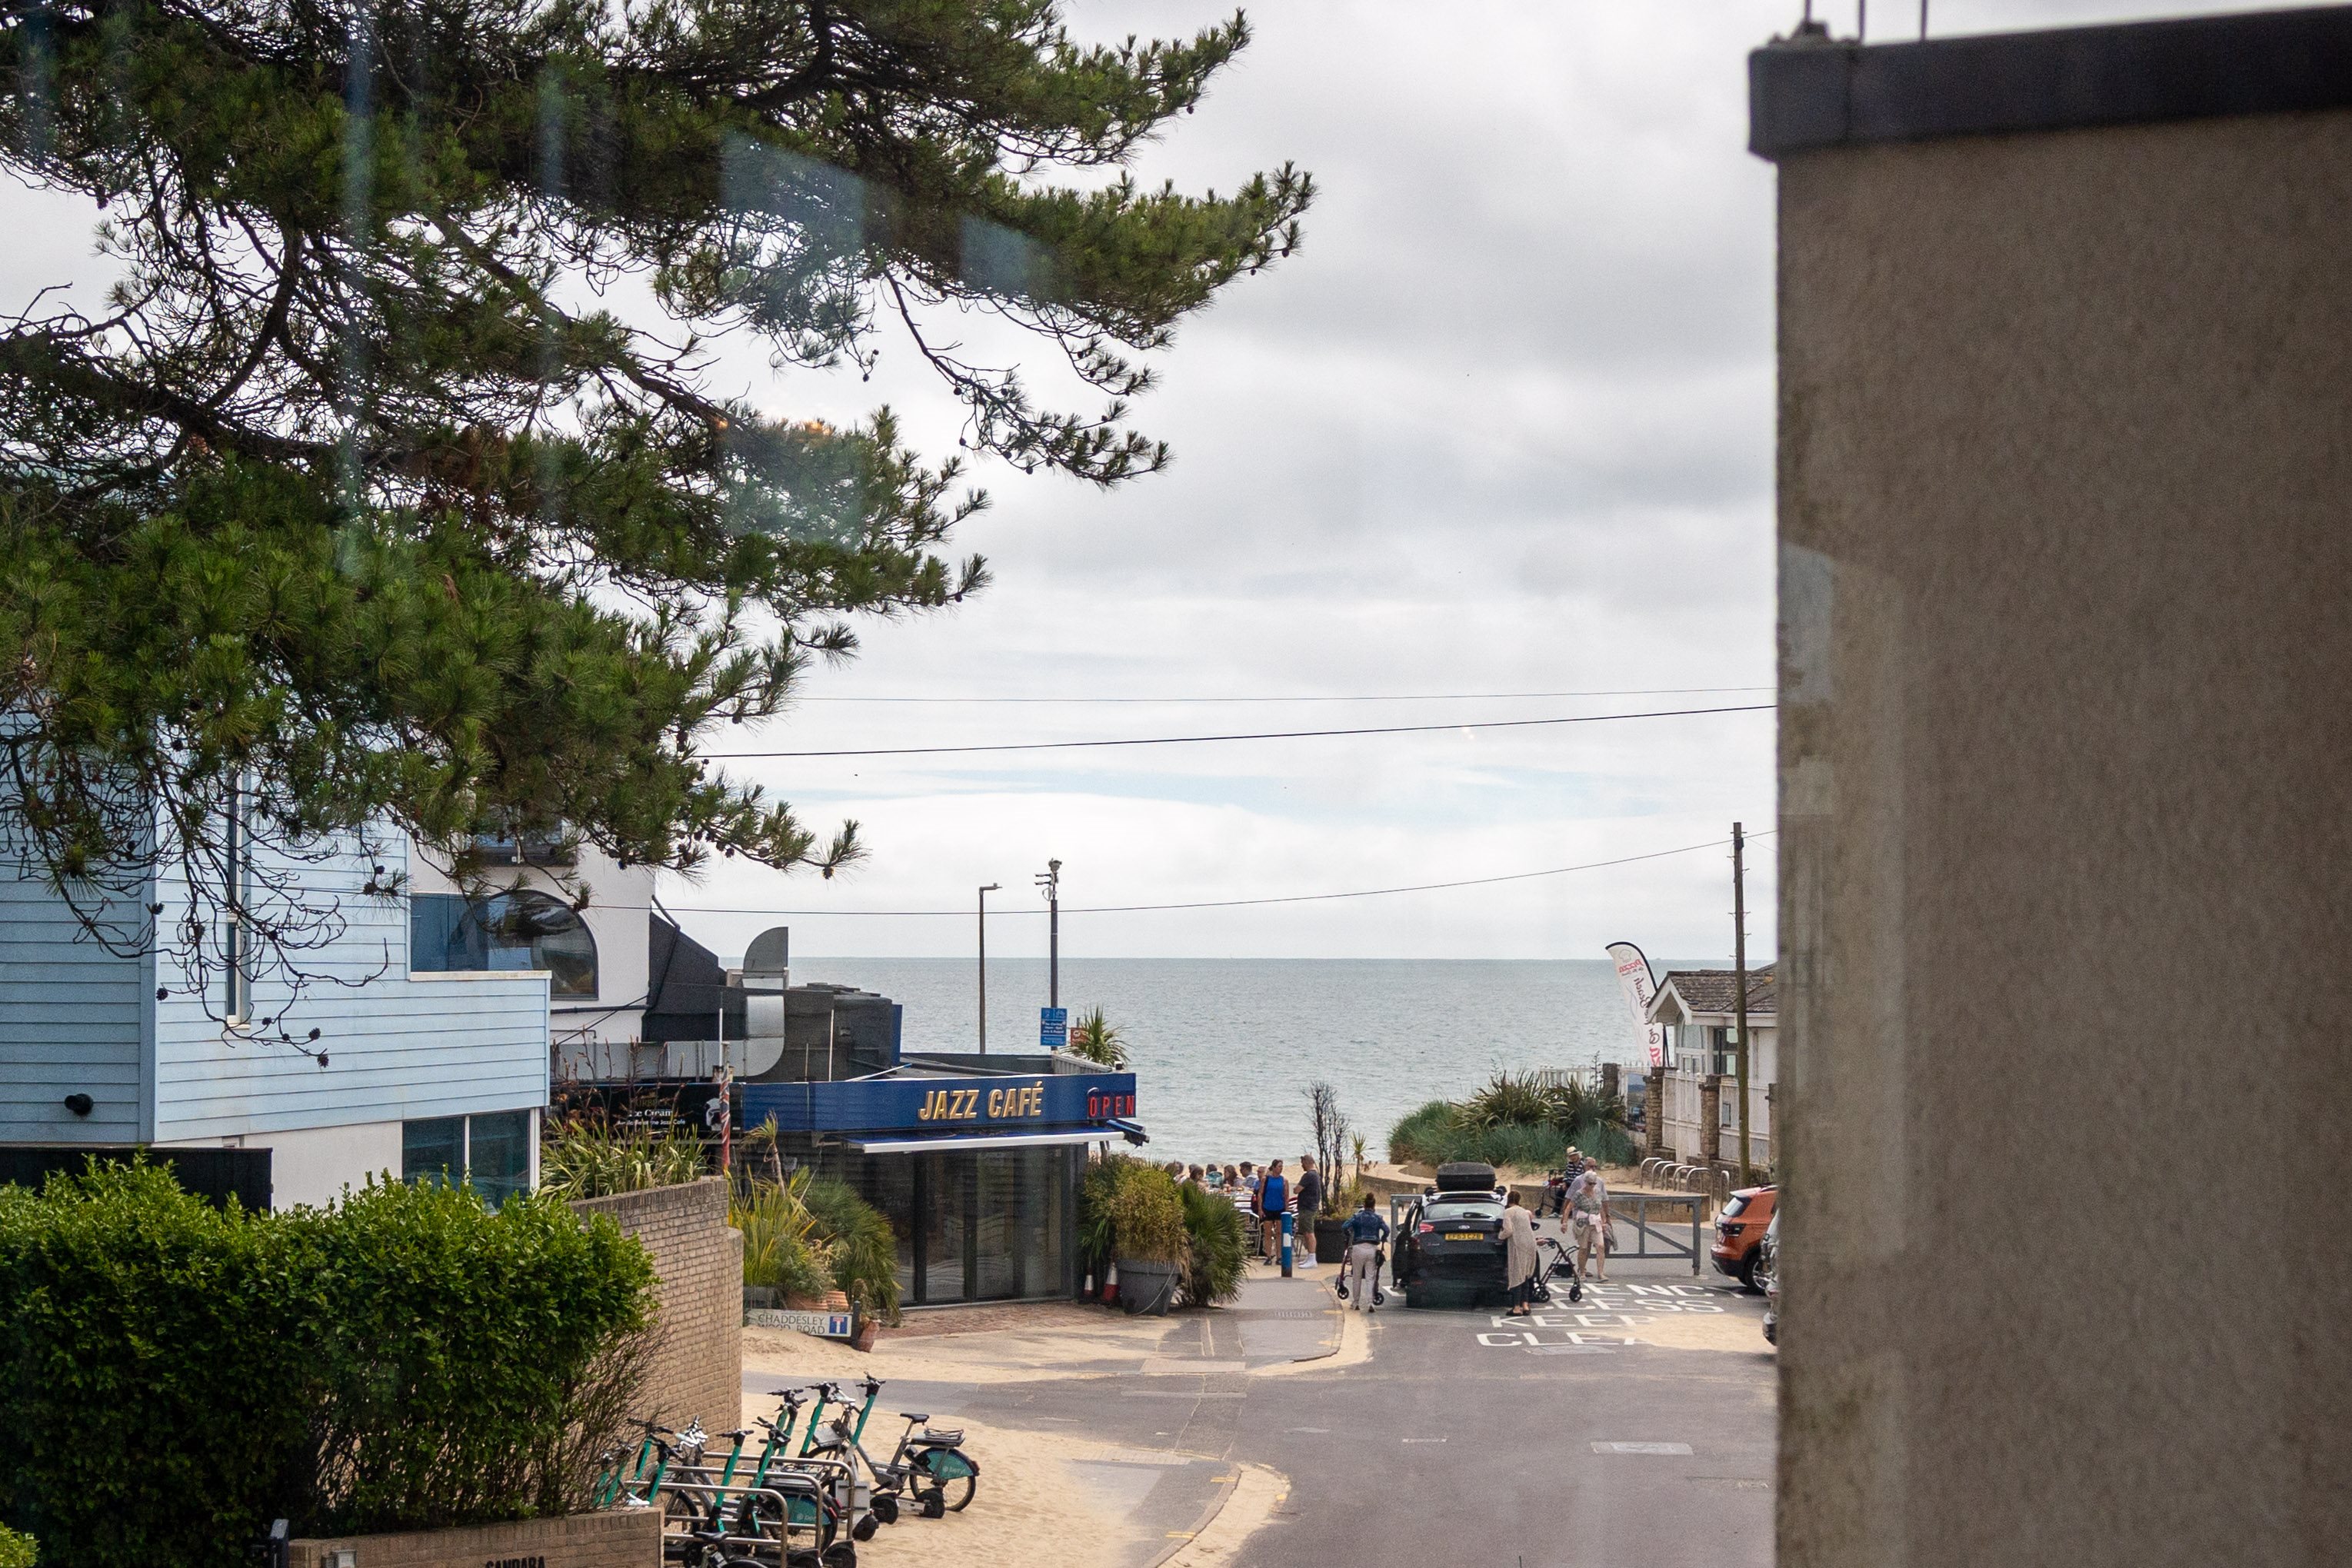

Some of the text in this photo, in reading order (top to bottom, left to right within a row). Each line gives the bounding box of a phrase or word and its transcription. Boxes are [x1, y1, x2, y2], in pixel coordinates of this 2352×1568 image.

[918, 1080, 1044, 1120] JAZZ CAFÉ
[1088, 1095, 1134, 1117] OPEN
[1527, 1298, 1725, 1313] CESS
[758, 1313, 825, 1326] CHADDESLEY
[1491, 1315, 1658, 1328] KEEP
[797, 1325, 825, 1335] ROAD
[1477, 1332, 1654, 1347] CLE
